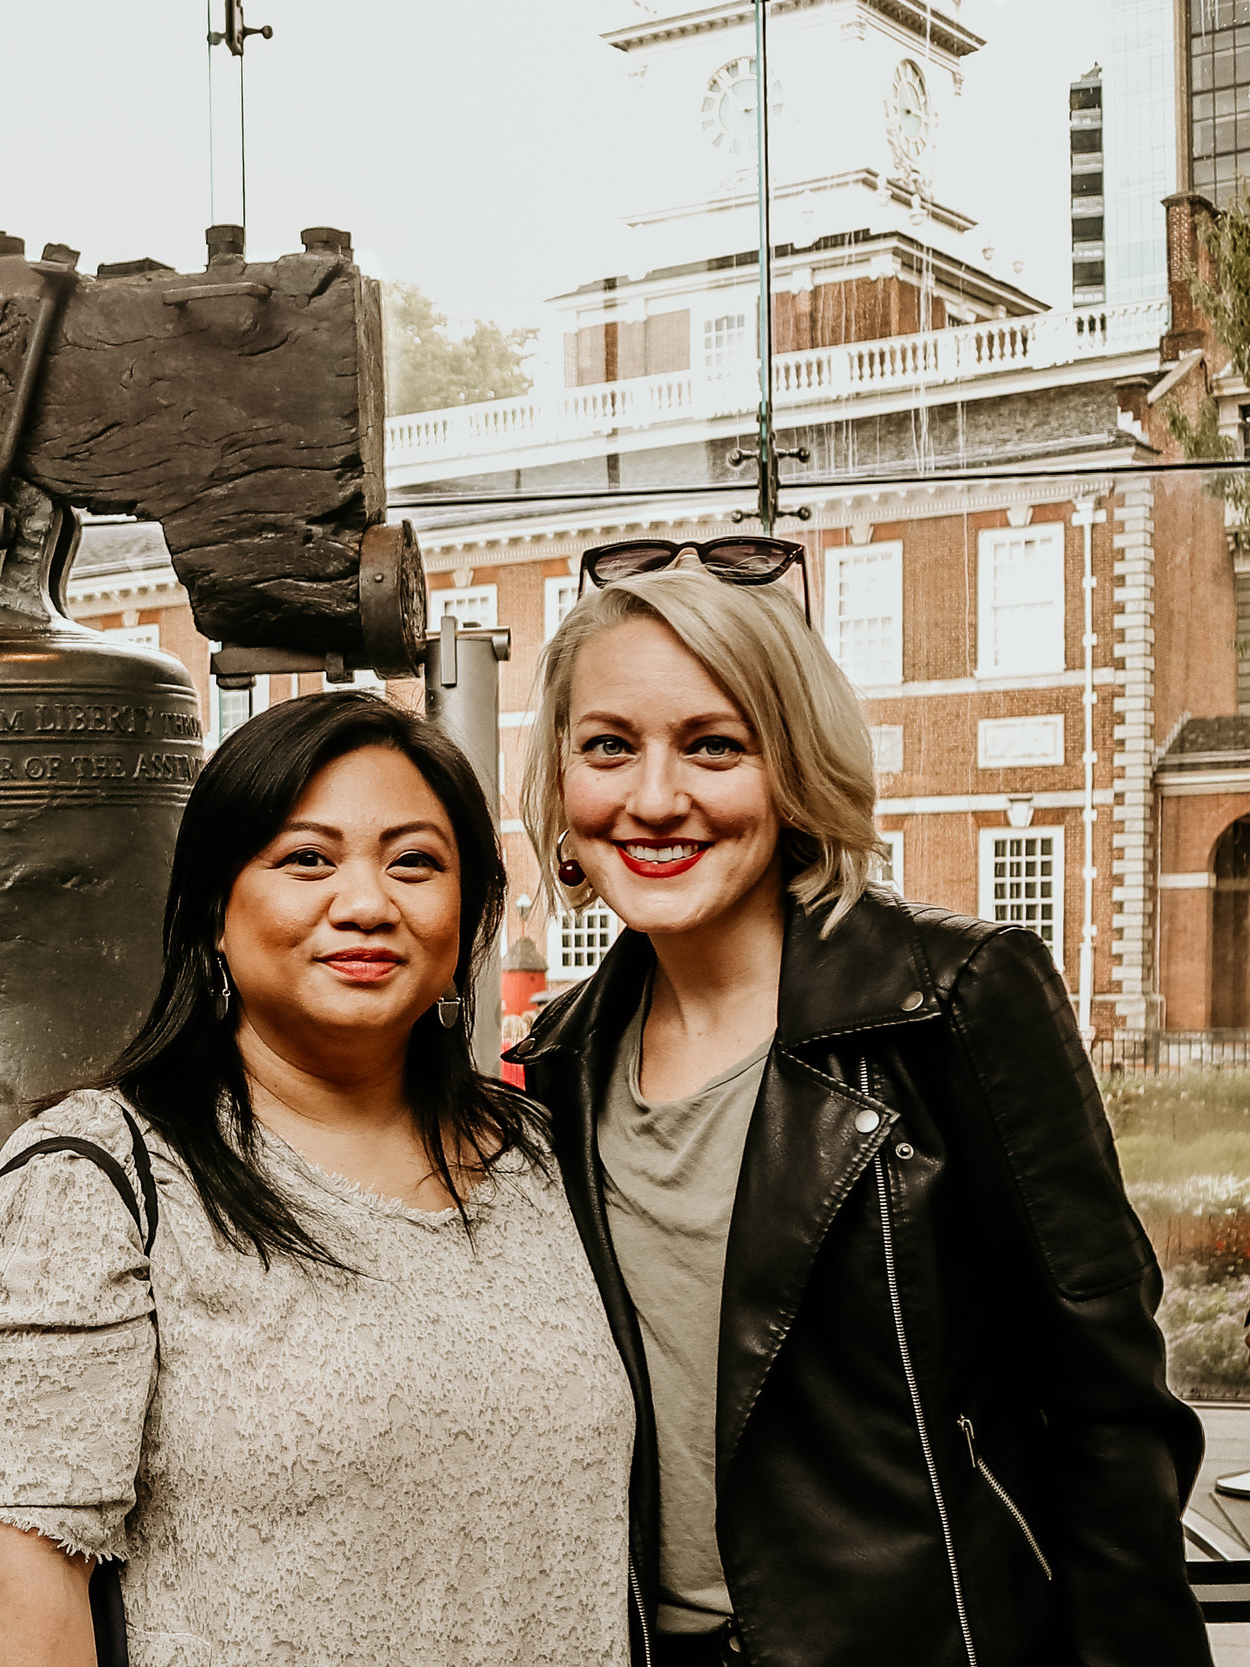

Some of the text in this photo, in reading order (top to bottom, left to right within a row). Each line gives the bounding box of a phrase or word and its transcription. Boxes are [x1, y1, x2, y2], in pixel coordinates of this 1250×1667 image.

[35, 703, 156, 734] LIBERTY
[24, 754, 63, 780] OF
[71, 754, 126, 780] THE
